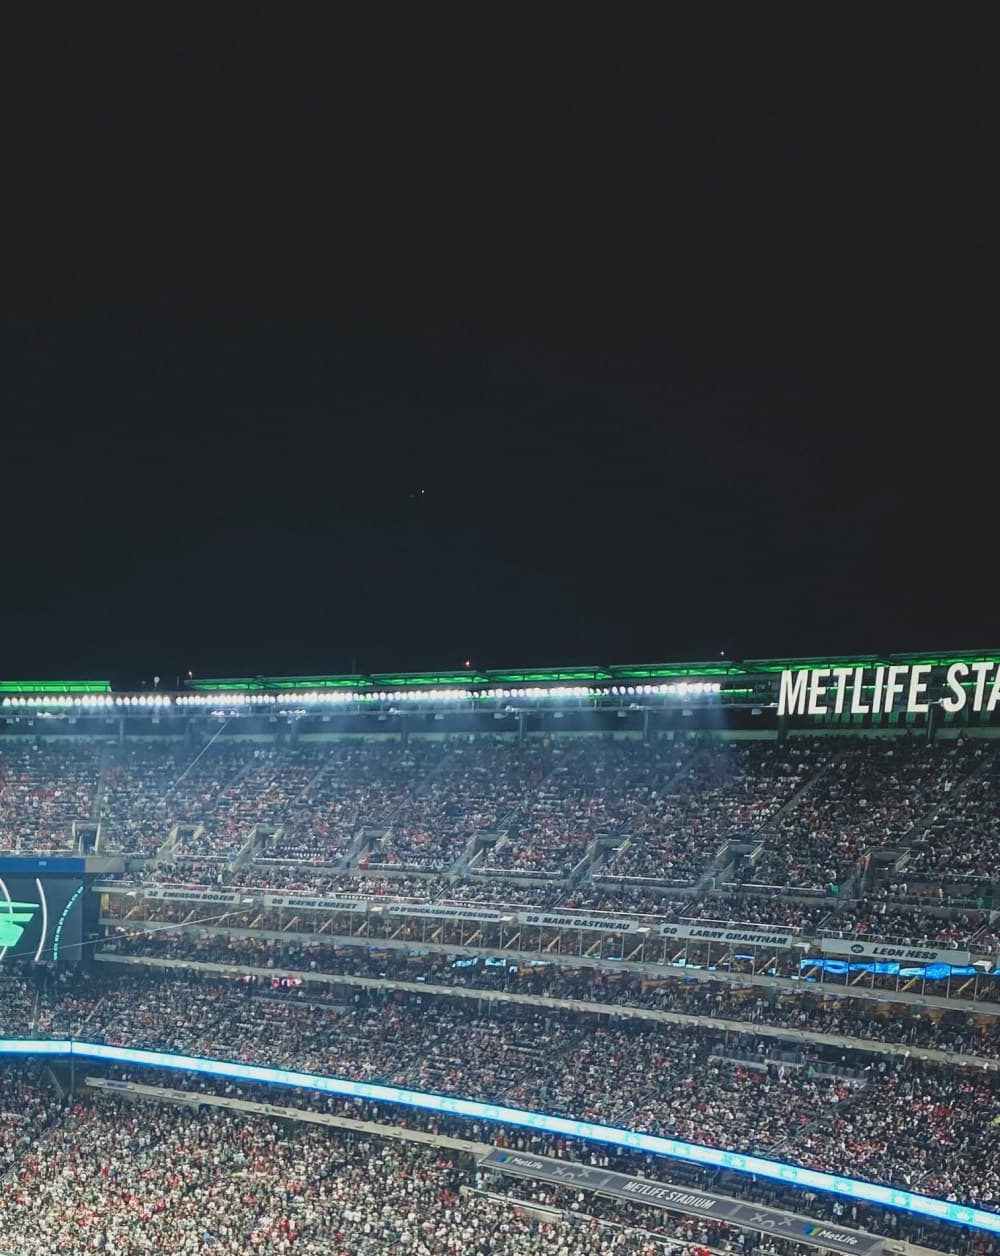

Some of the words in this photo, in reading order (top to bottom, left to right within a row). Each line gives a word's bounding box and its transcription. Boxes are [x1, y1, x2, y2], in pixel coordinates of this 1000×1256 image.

[777, 664, 932, 716] METLIFE
[288, 899, 317, 908] WAYNE
[542, 915, 572, 926] MARK
[573, 918, 631, 932] GASTINEAU
[662, 926, 678, 936] 60
[688, 928, 725, 941] LARRY
[725, 931, 789, 946] GRANTHAM
[871, 946, 906, 959] LEON
[510, 1156, 544, 1171] MetLife
[622, 1180, 670, 1202] METLIFE
[670, 1187, 716, 1211] STADIUM
[819, 1226, 859, 1246] MetLife
